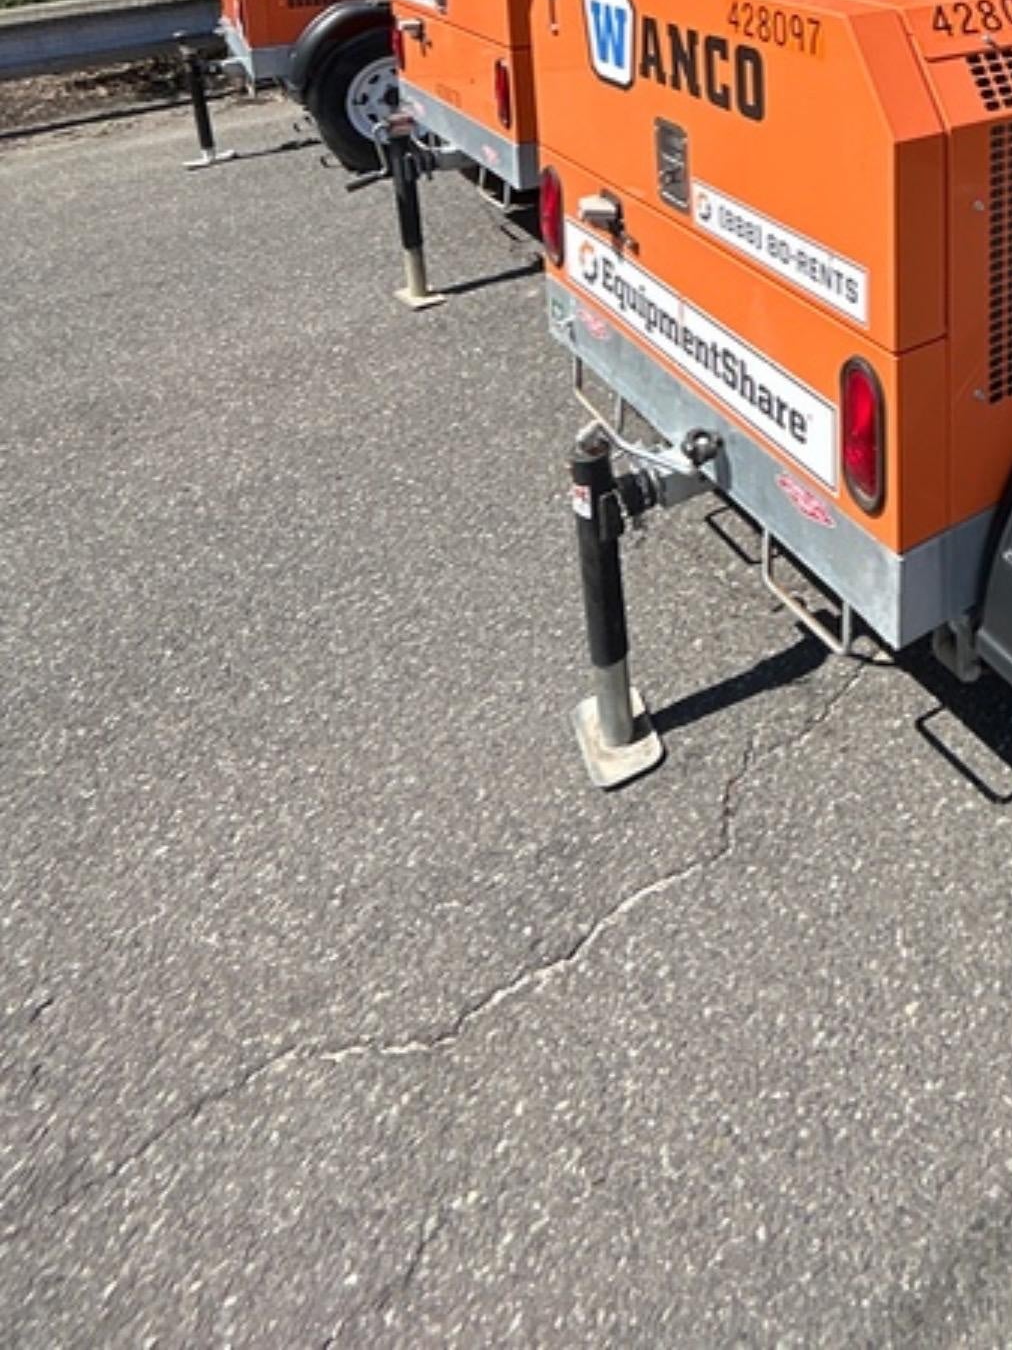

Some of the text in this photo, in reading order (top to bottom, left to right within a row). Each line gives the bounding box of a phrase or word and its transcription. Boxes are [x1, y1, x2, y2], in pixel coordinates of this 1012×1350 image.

[728, 1, 822, 55] 428097
[717, 204, 860, 304] (888) 80-RENTS
[602, 255, 808, 444] EquipmentShare
